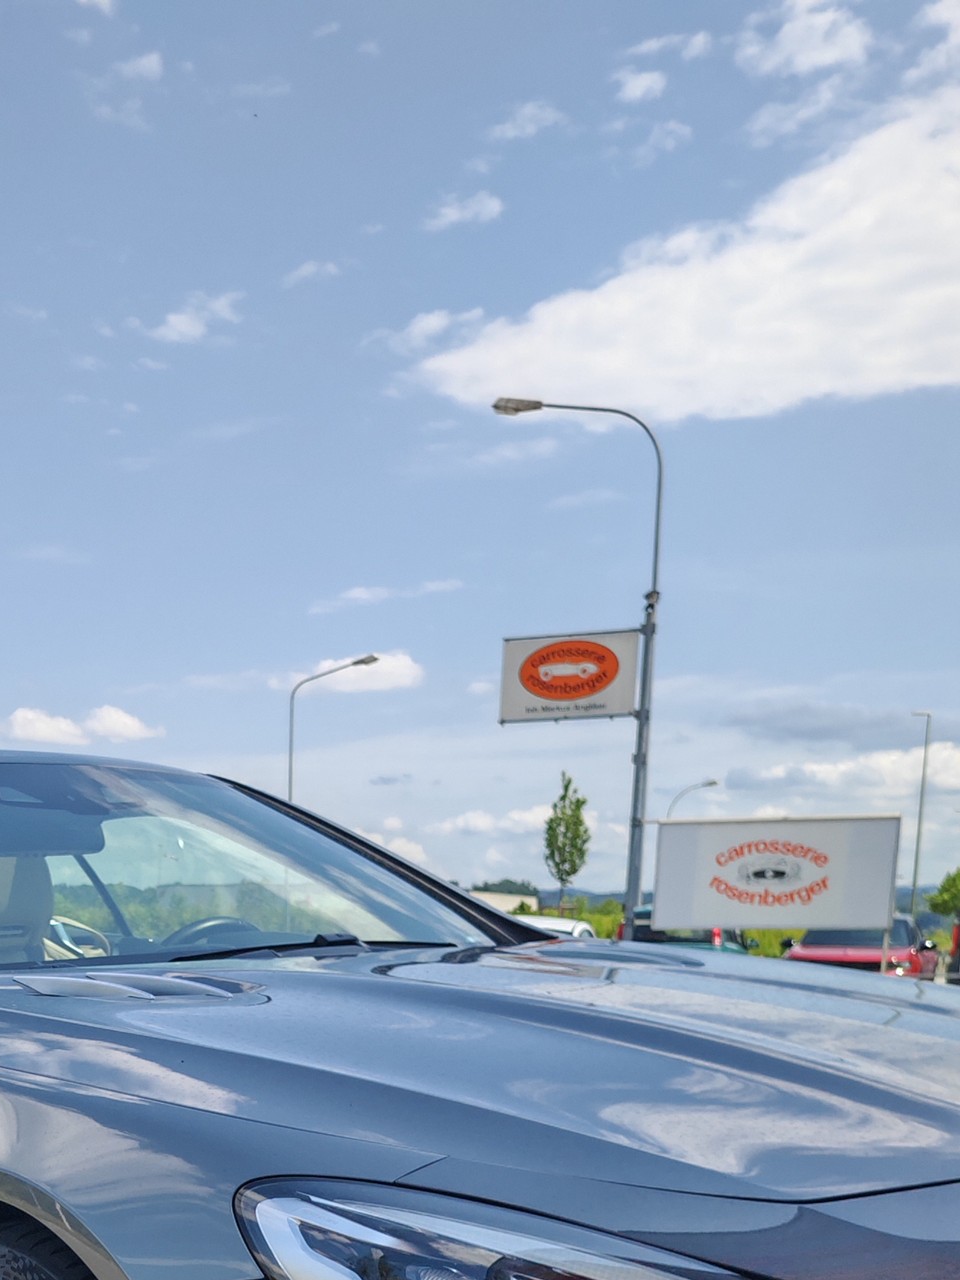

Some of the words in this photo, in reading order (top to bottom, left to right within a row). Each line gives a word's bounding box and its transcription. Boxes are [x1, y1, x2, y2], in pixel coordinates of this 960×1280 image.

[527, 670, 608, 695] rosenberger
[716, 840, 828, 867] carrosserie
[709, 876, 828, 906] rosenberger
